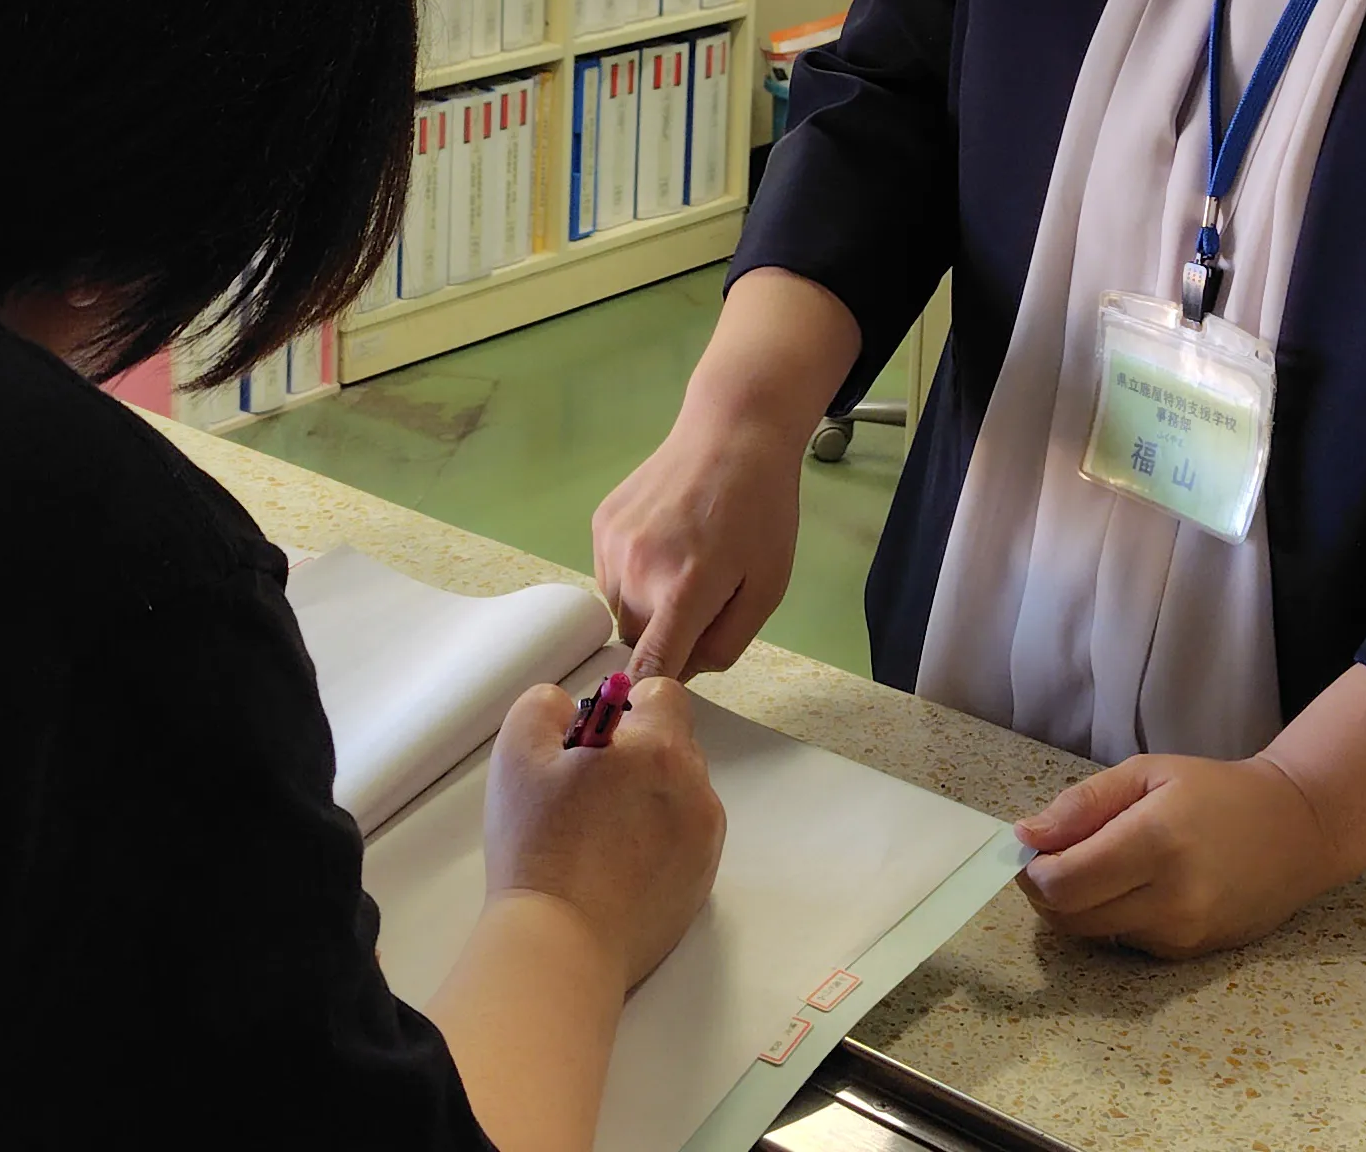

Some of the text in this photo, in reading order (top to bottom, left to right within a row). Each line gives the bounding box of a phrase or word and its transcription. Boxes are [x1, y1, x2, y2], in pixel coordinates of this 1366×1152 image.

[1116, 372, 1238, 433] 県立鹿屋特別支援学校
